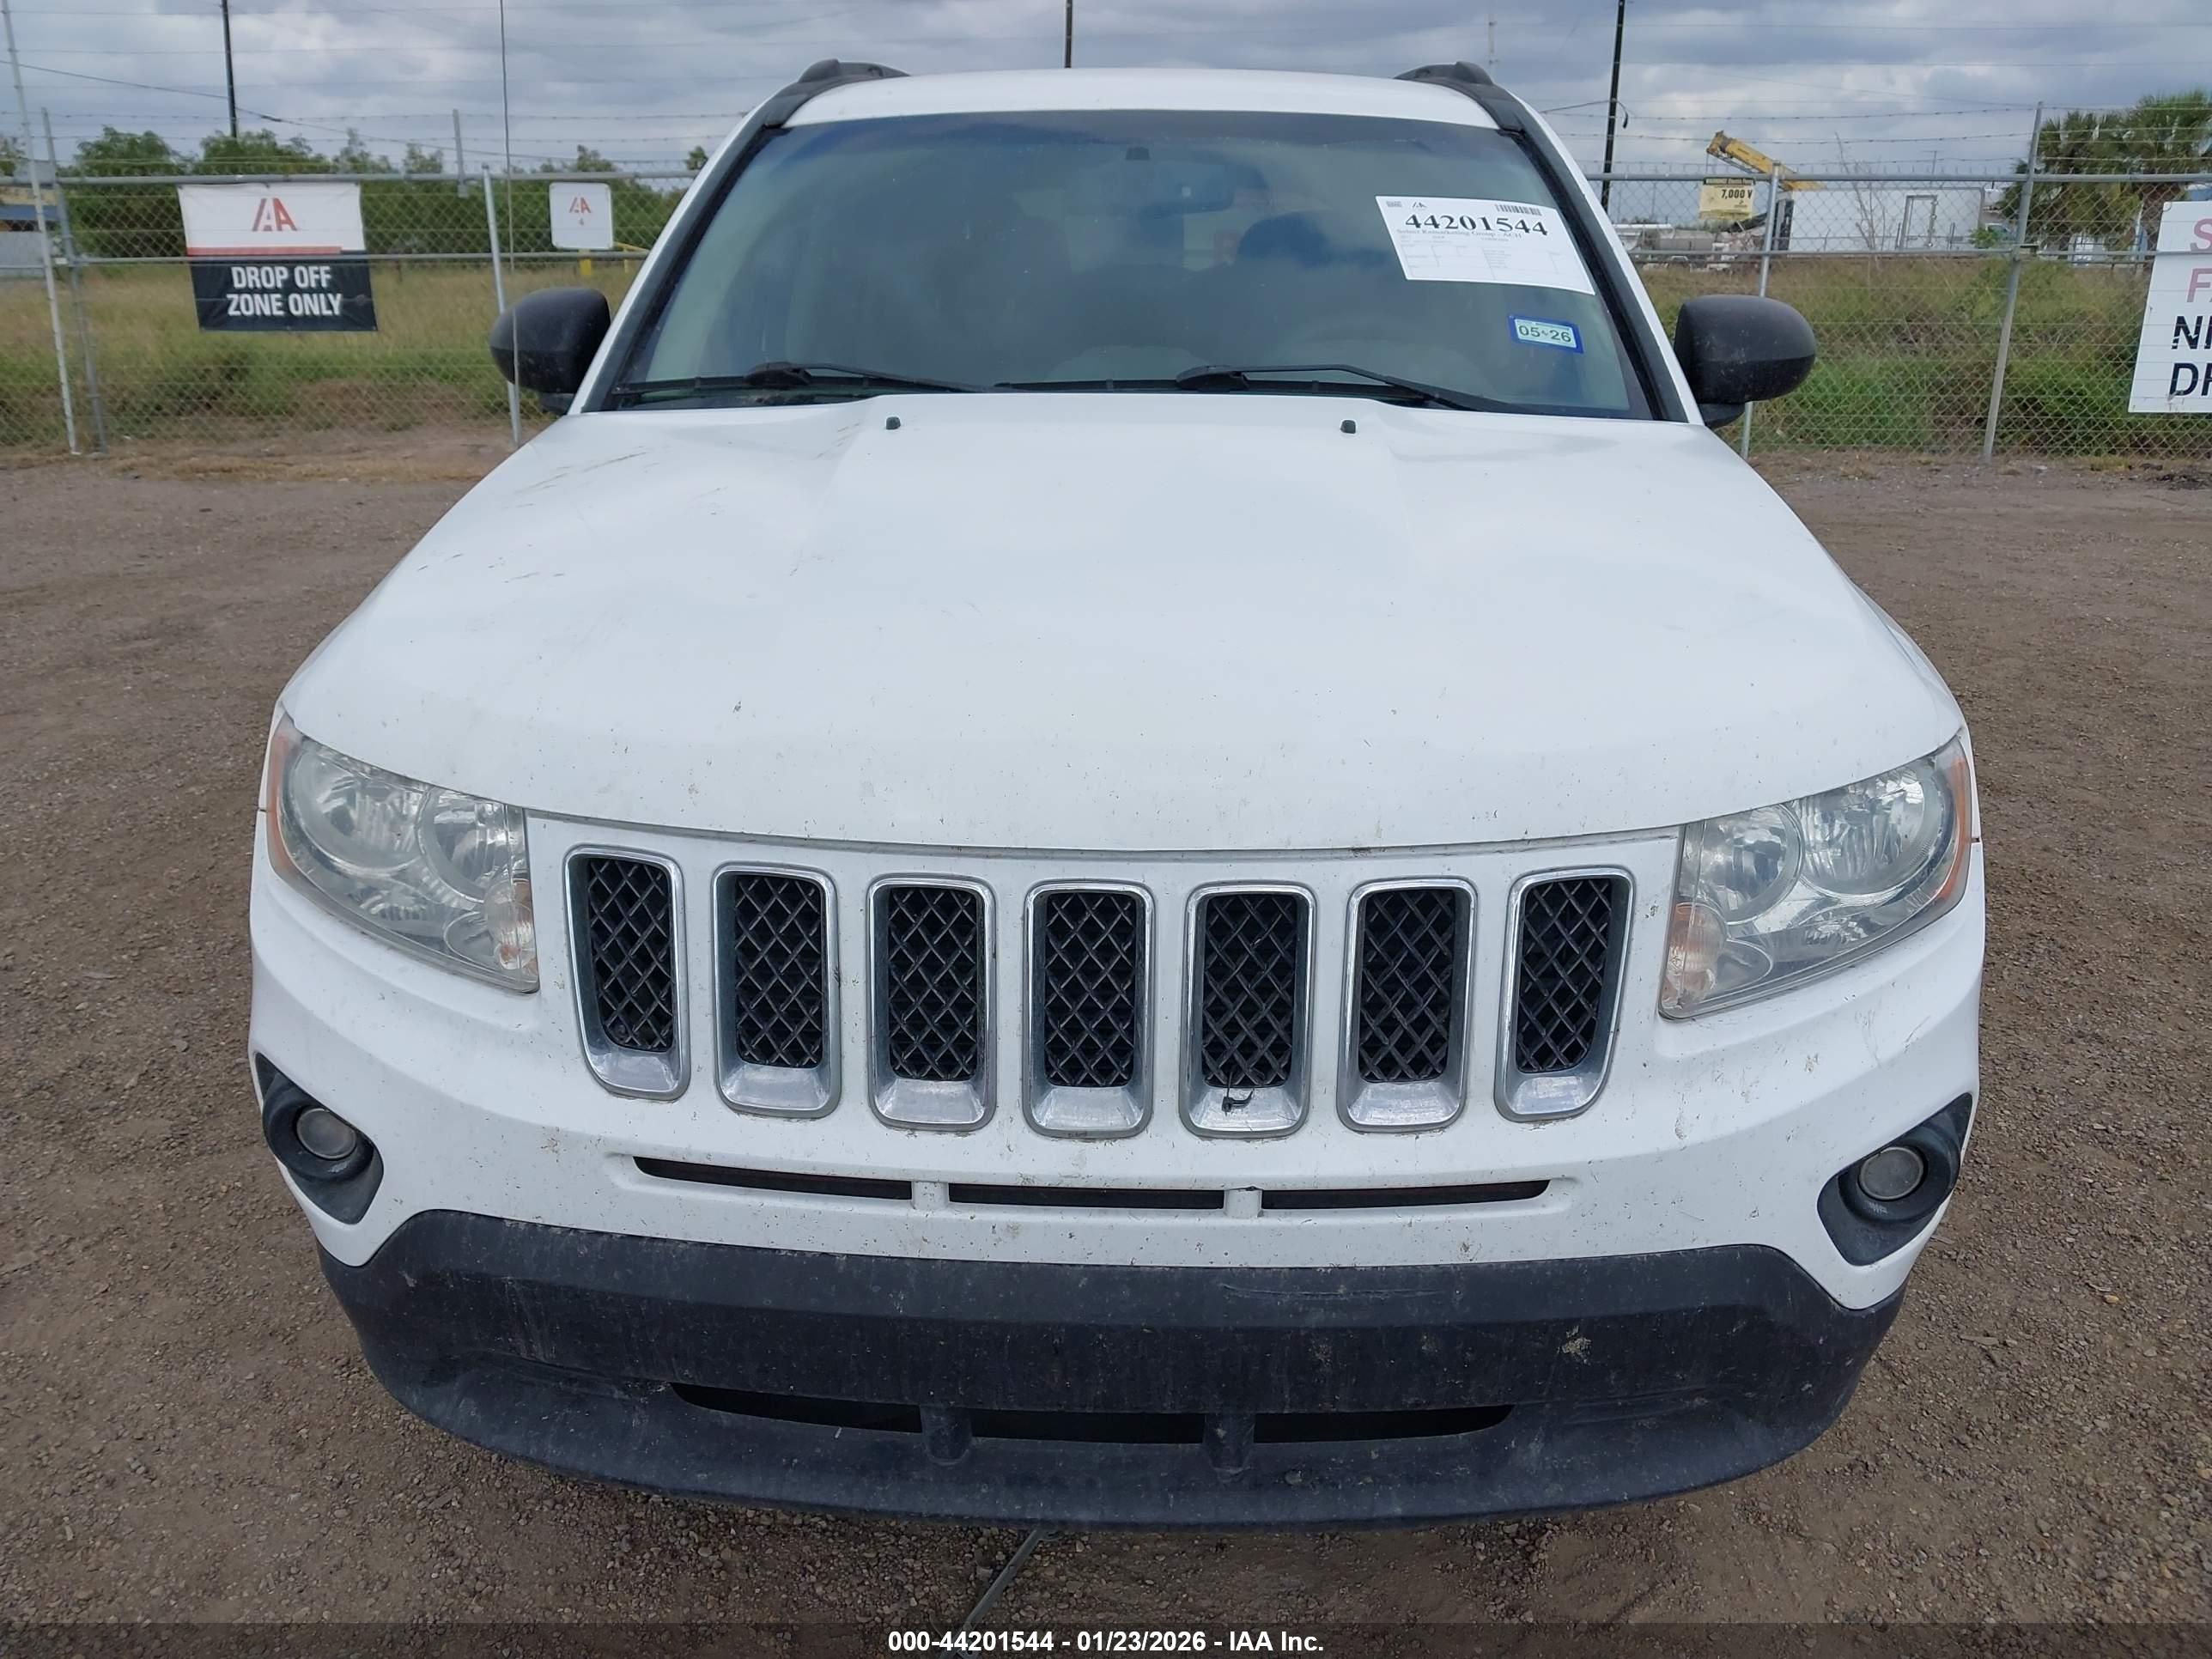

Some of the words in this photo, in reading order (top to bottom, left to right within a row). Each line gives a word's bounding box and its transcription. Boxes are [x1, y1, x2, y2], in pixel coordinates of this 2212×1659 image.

[1722, 189, 1745, 199] 7,000
[1405, 214, 1548, 236] 44201544
[231, 266, 289, 289] DROP
[294, 266, 331, 289] OFF
[227, 294, 284, 315] ZONE
[289, 293, 342, 315] ONLY
[1518, 325, 1540, 337] 05
[1549, 330, 1571, 343] 26
